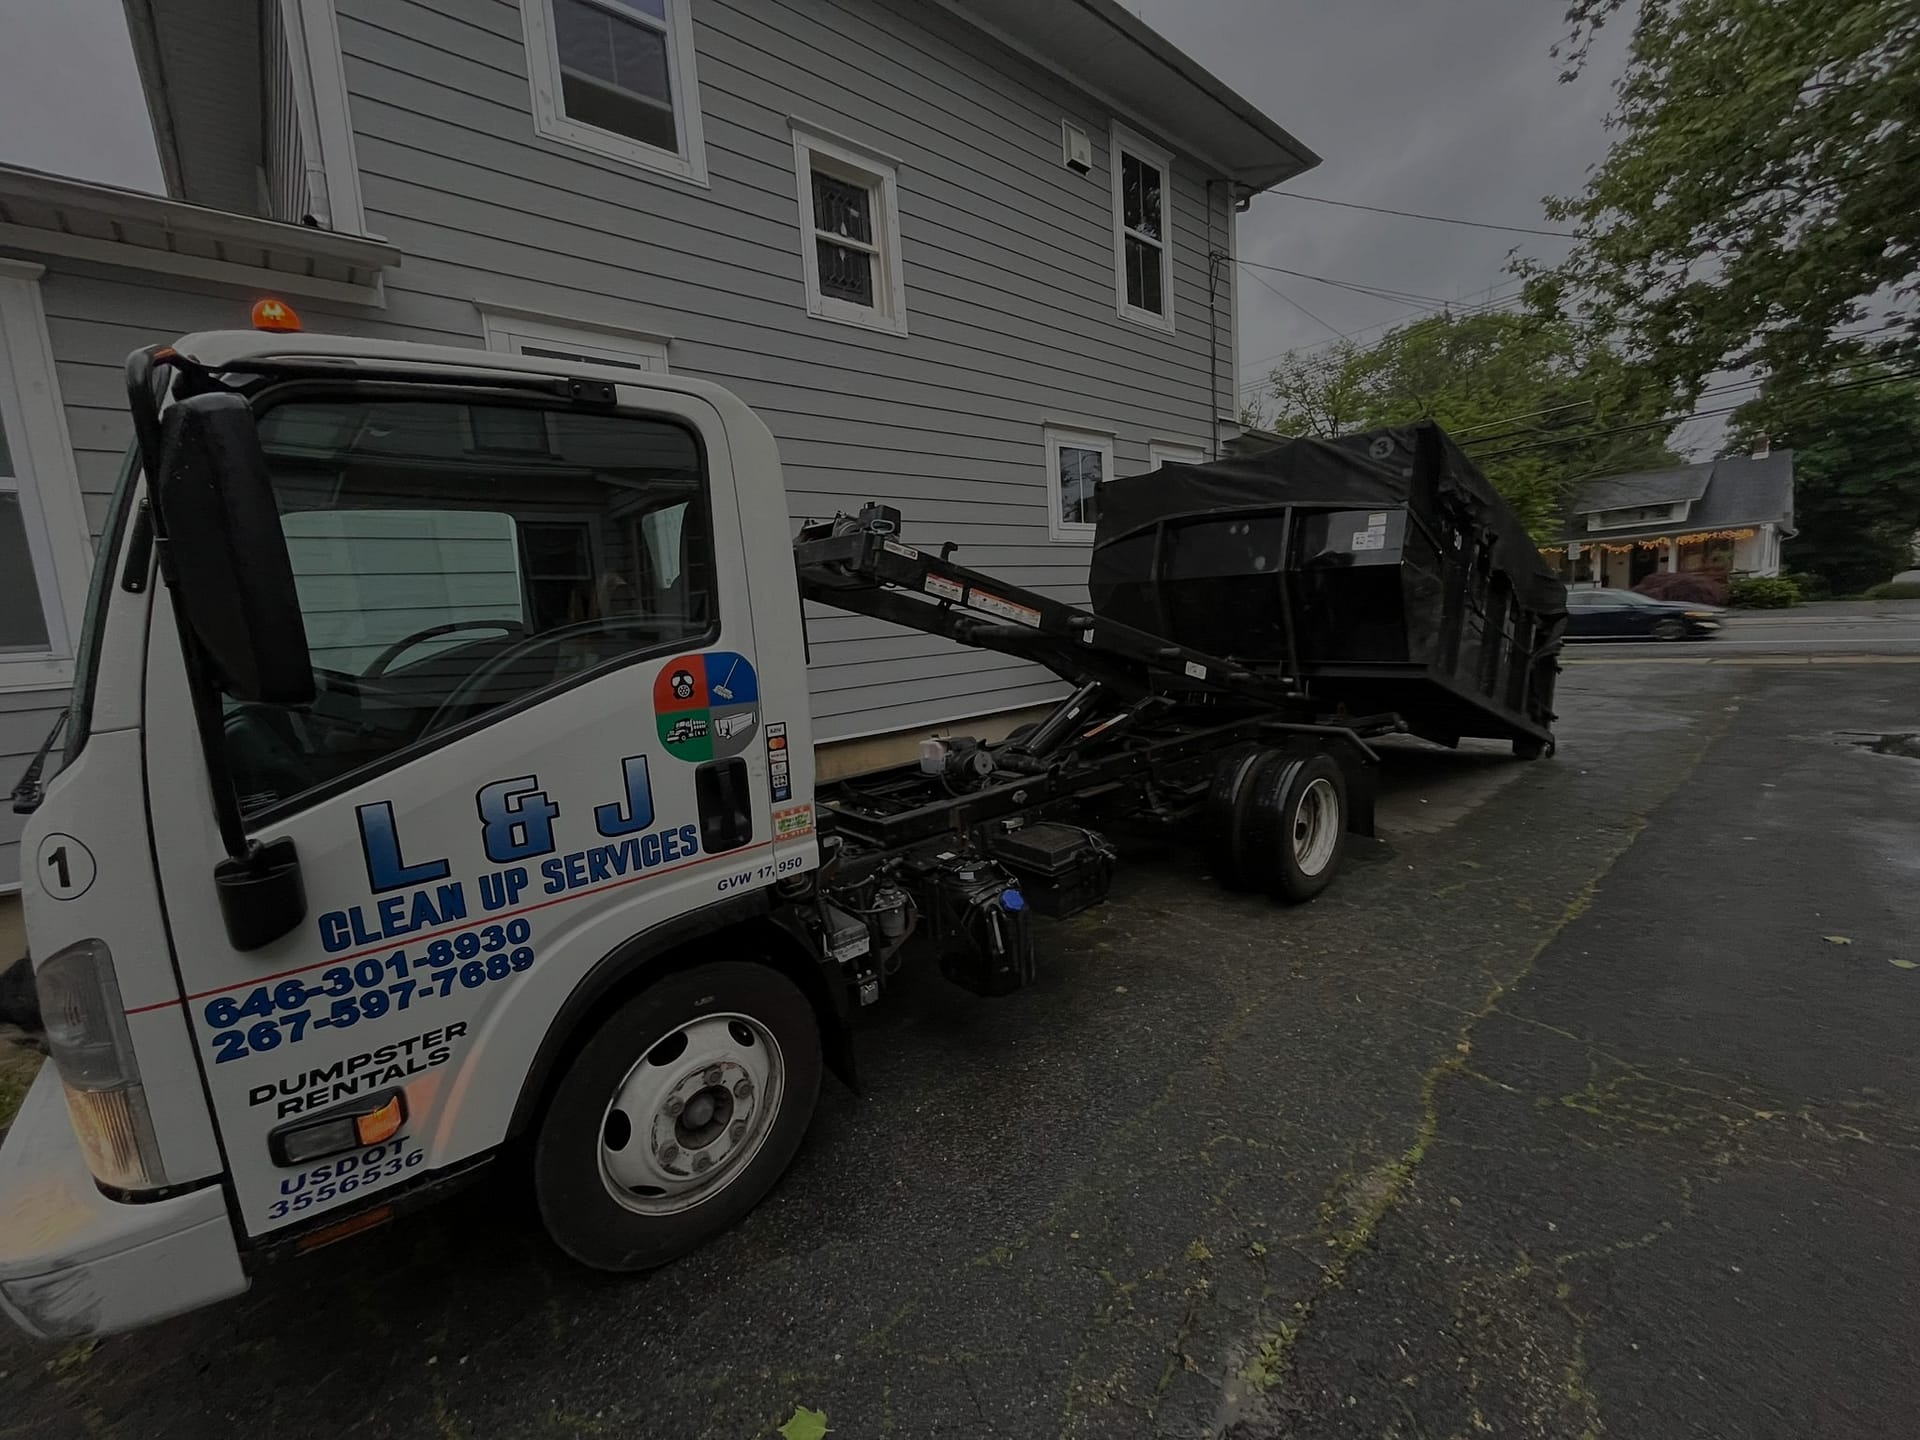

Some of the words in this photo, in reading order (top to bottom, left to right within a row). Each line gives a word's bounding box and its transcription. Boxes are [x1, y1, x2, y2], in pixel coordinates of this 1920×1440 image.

[1376, 441, 1388, 455] 3
[355, 800, 450, 894] L
[476, 775, 559, 864] &
[594, 754, 655, 837] J
[48, 846, 71, 888] 1
[318, 882, 467, 953] CLEAN
[478, 867, 529, 911] UP
[541, 824, 698, 894] SERVICES
[717, 871, 752, 891] GVW
[204, 918, 531, 1029] 646-301-8930
[212, 947, 534, 1064] 267-597-7689
[249, 1021, 467, 1107] DUMPSTER
[277, 1047, 450, 1119] RENTALS
[268, 1149, 424, 1219] 3556536
[280, 1136, 411, 1195] USDOT
